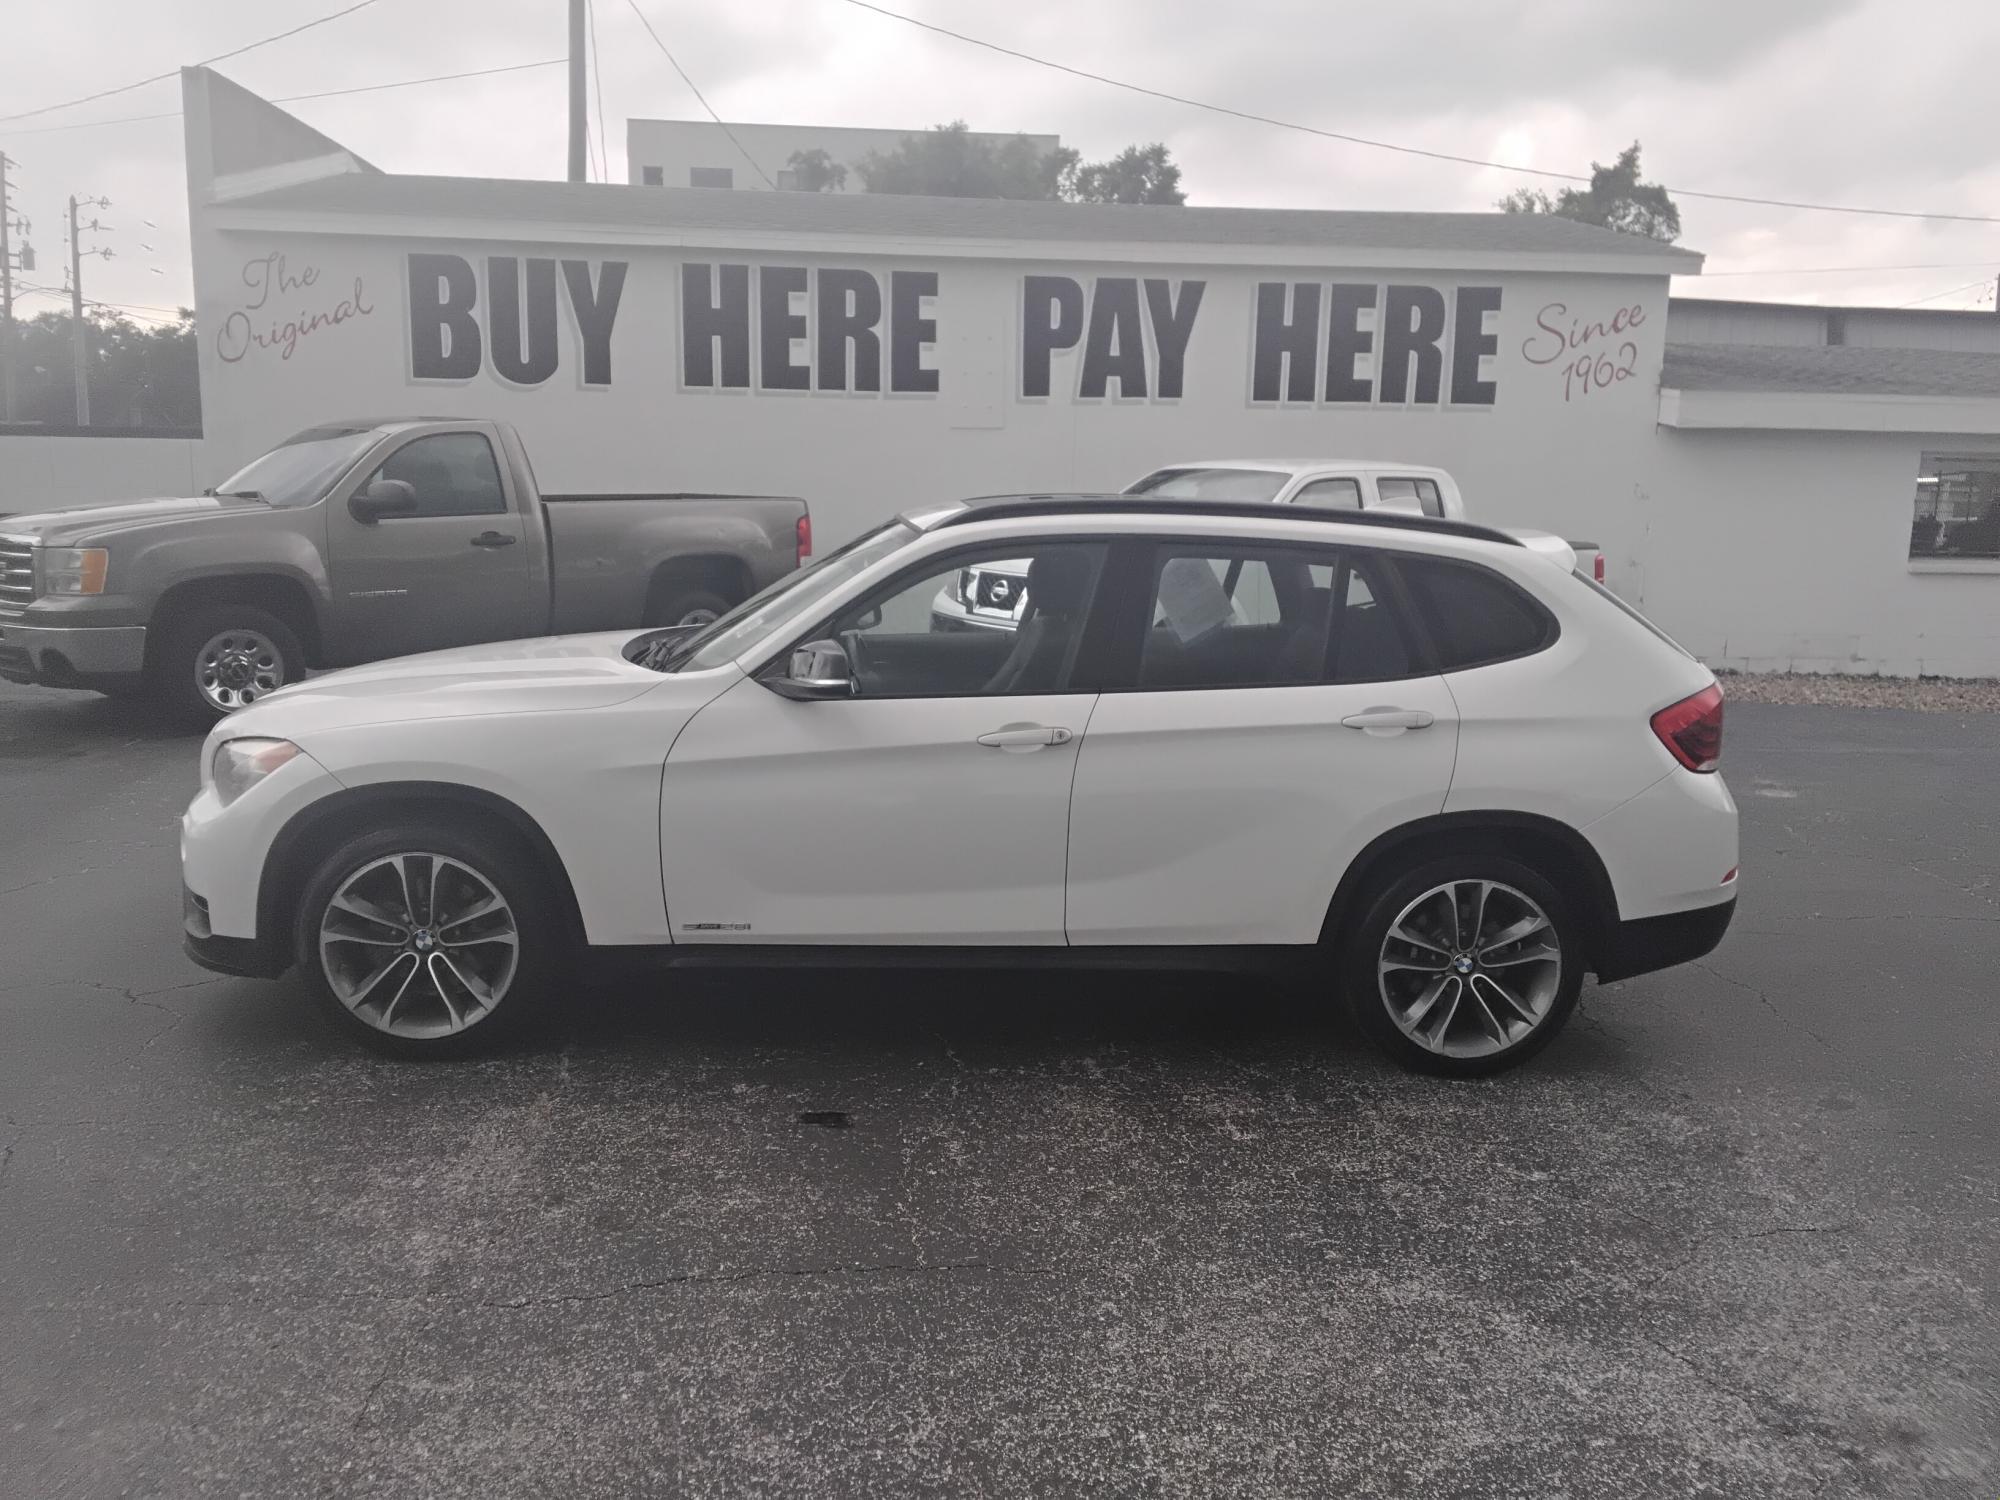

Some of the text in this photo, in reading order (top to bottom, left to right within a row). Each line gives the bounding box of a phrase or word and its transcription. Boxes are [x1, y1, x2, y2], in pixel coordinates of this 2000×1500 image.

[242, 251, 320, 310] The
[216, 277, 374, 363] Original
[407, 252, 1503, 405] BUY HERE PAY HERE
[1522, 302, 1647, 365] Since
[1561, 341, 1639, 402] 1962
